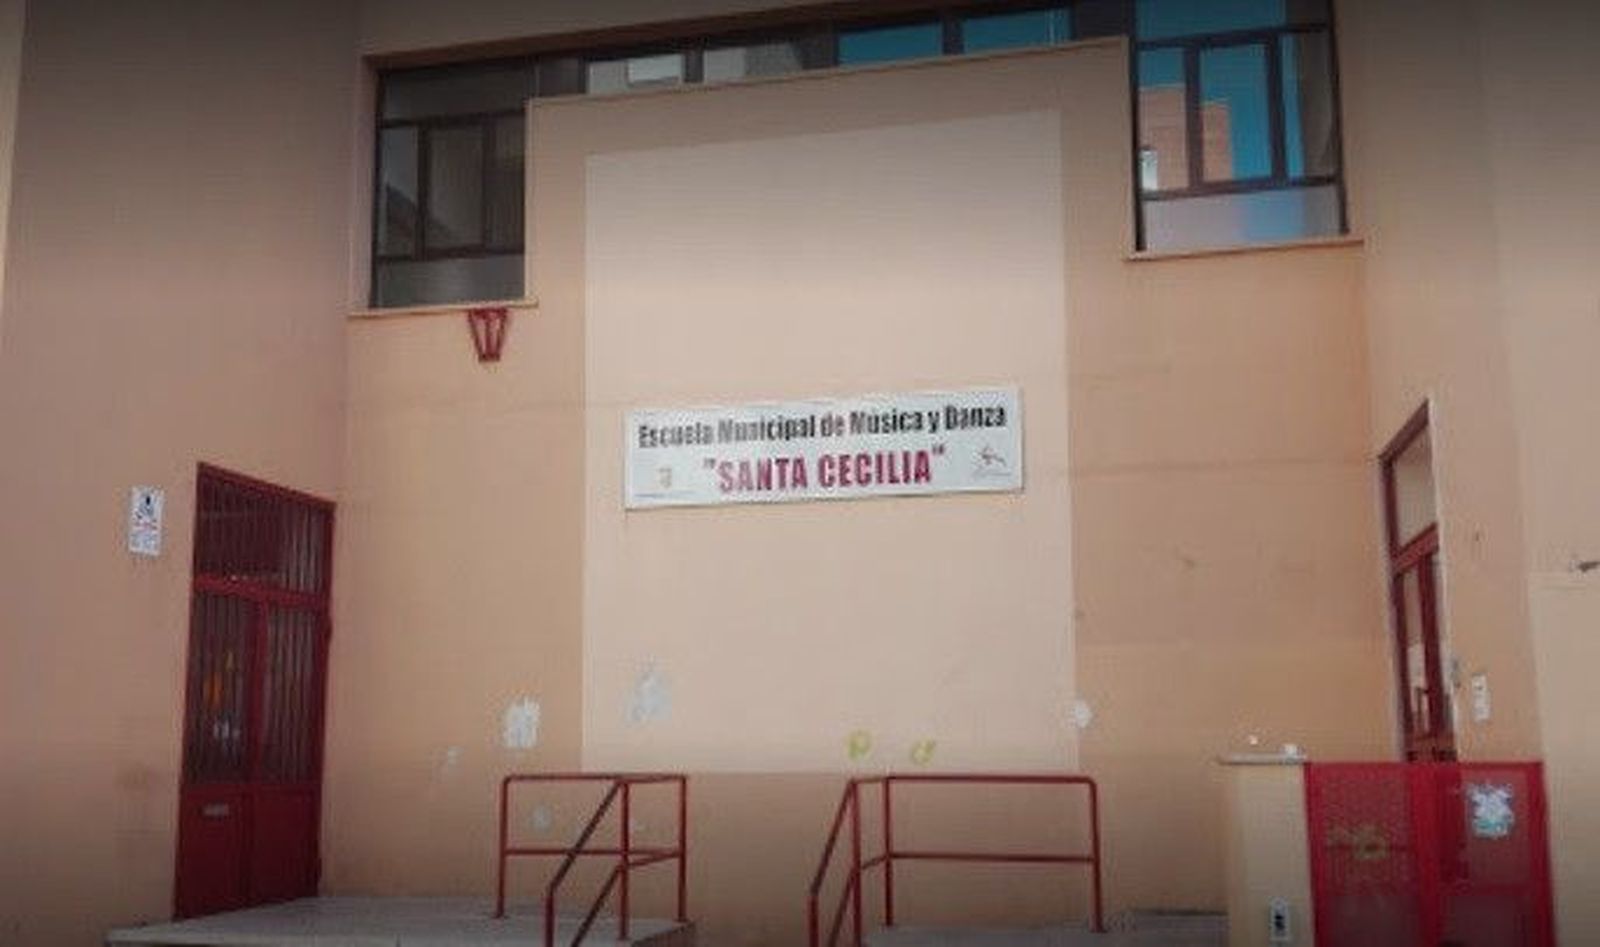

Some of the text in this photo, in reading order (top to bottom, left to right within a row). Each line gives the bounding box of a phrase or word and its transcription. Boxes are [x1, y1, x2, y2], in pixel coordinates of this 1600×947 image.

[638, 422, 713, 448] Escuela
[717, 414, 816, 443] Municipal
[820, 413, 844, 437] de
[927, 410, 939, 434] y
[945, 405, 1007, 429] Danza
